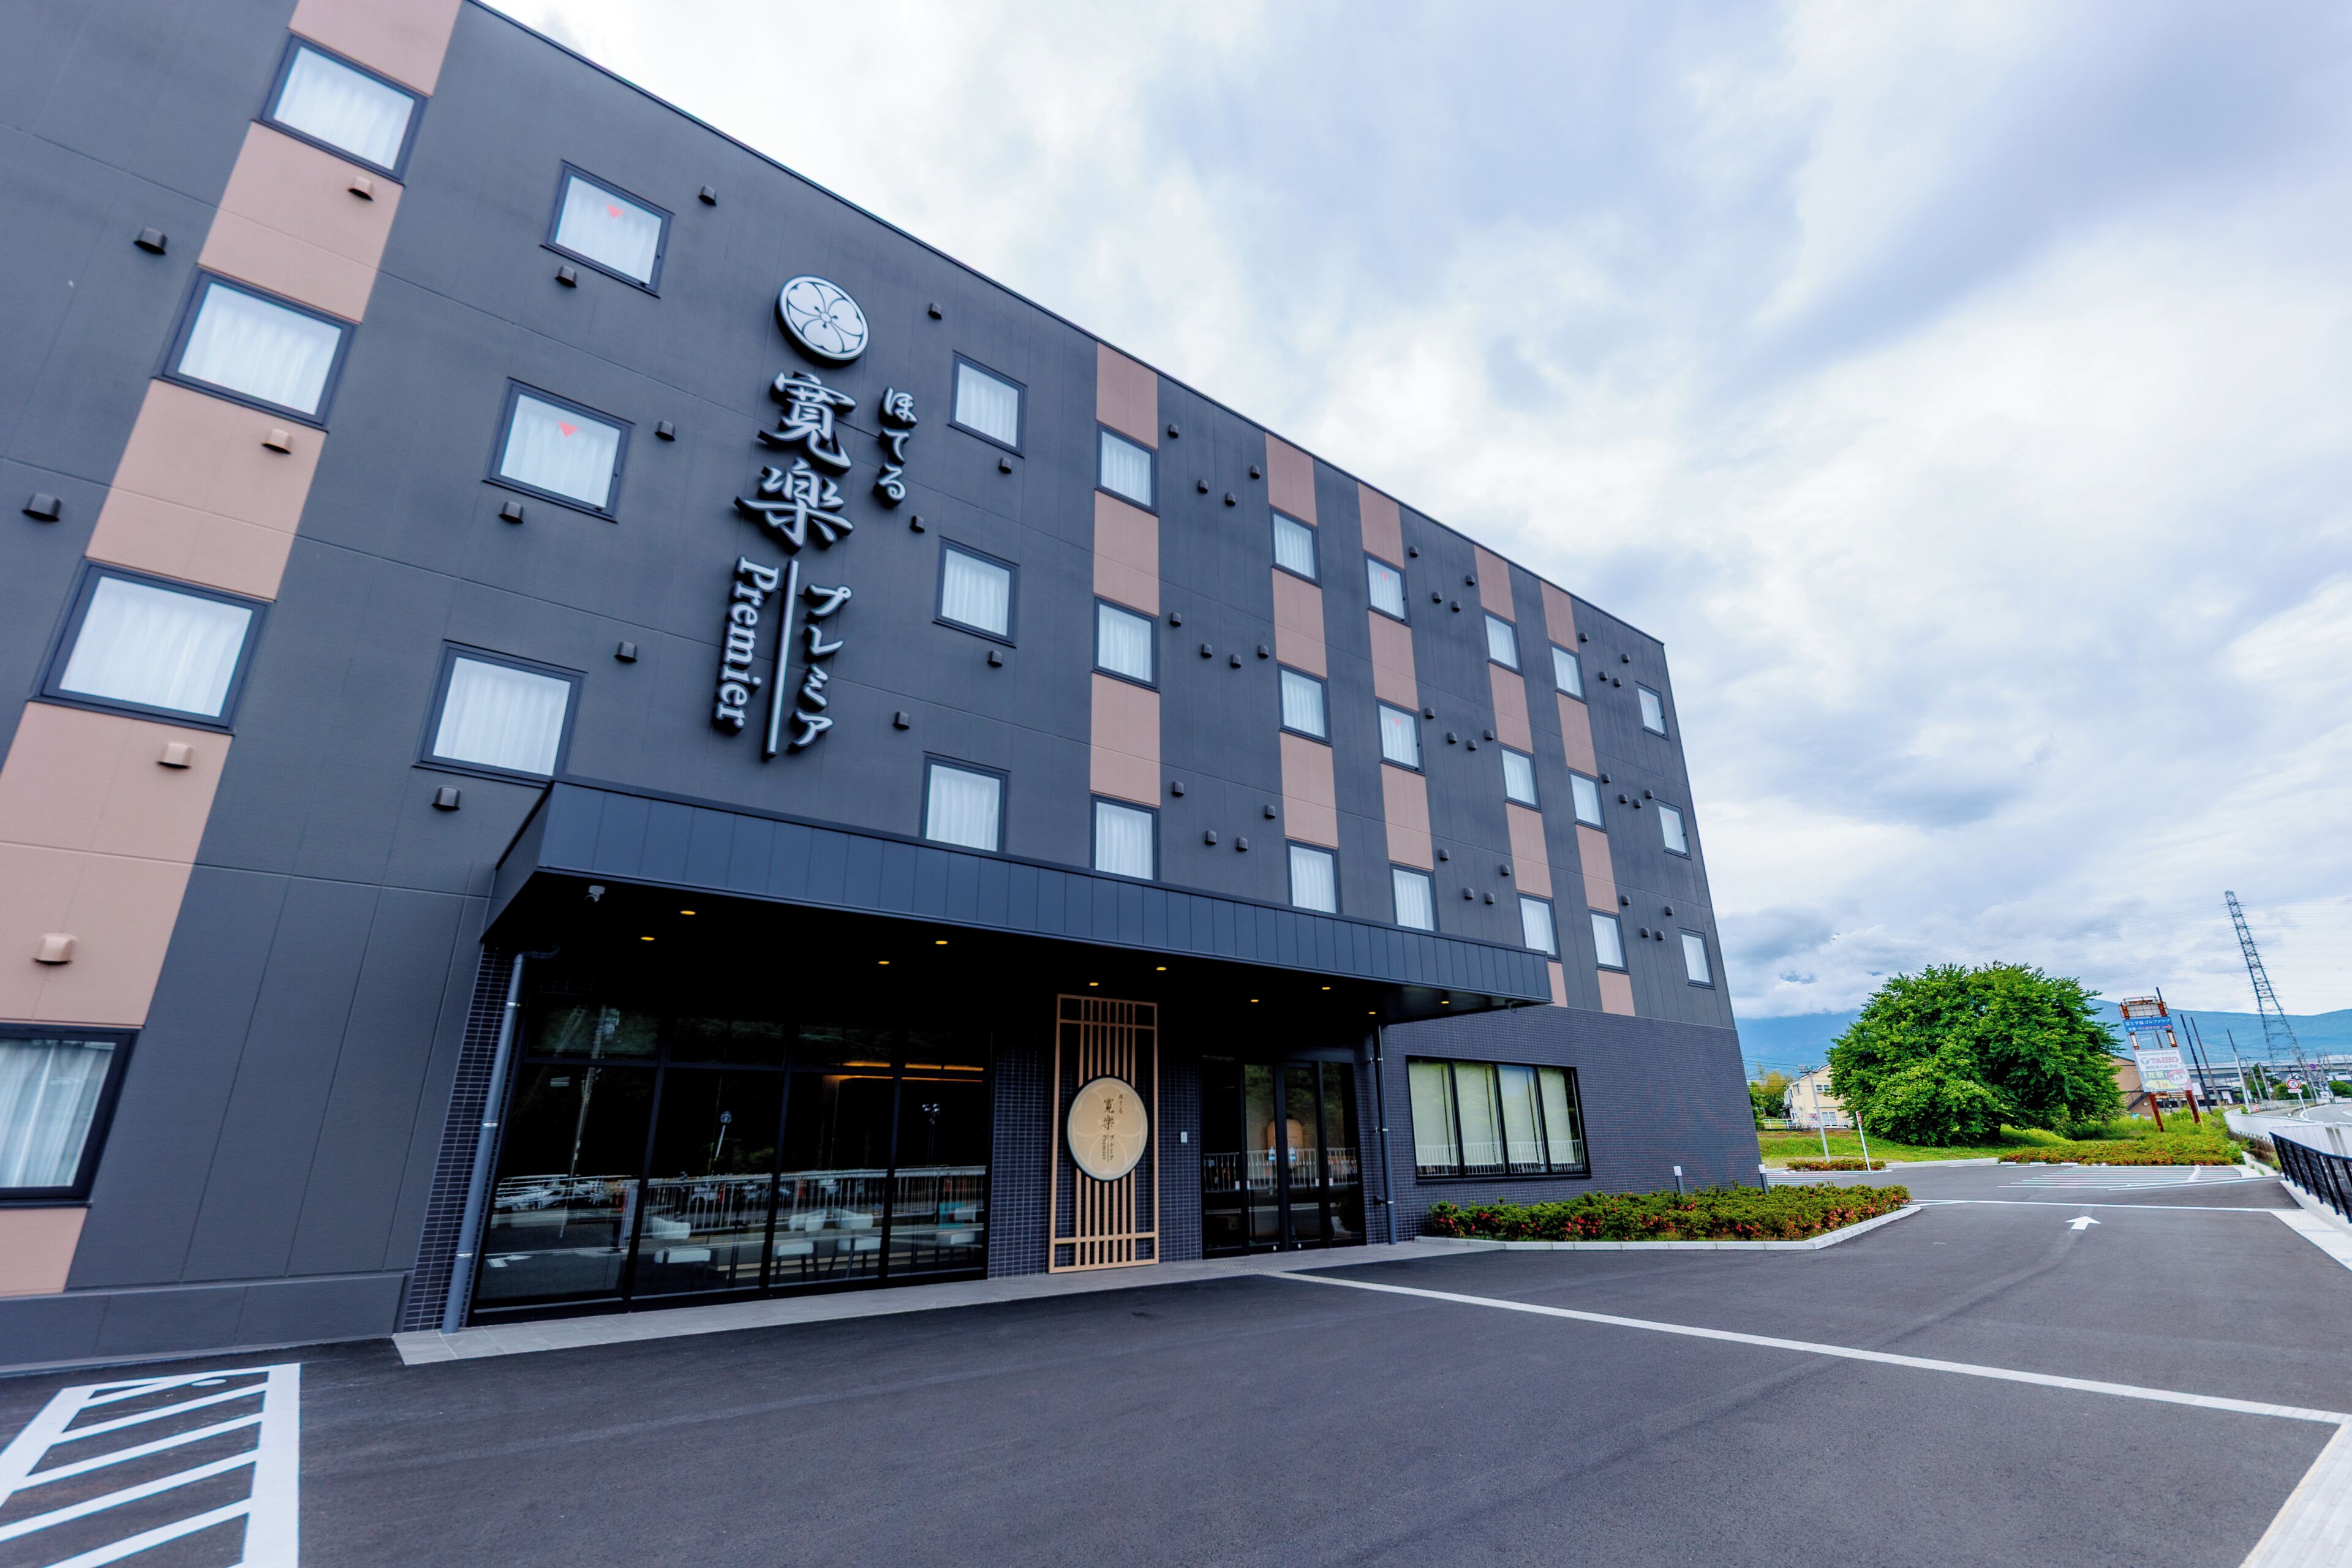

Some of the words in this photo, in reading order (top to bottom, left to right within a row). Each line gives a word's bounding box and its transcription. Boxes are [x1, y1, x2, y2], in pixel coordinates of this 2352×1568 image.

[879, 386, 918, 502] ほてる
[715, 555, 780, 729] Premier
[793, 583, 853, 747] プレミア
